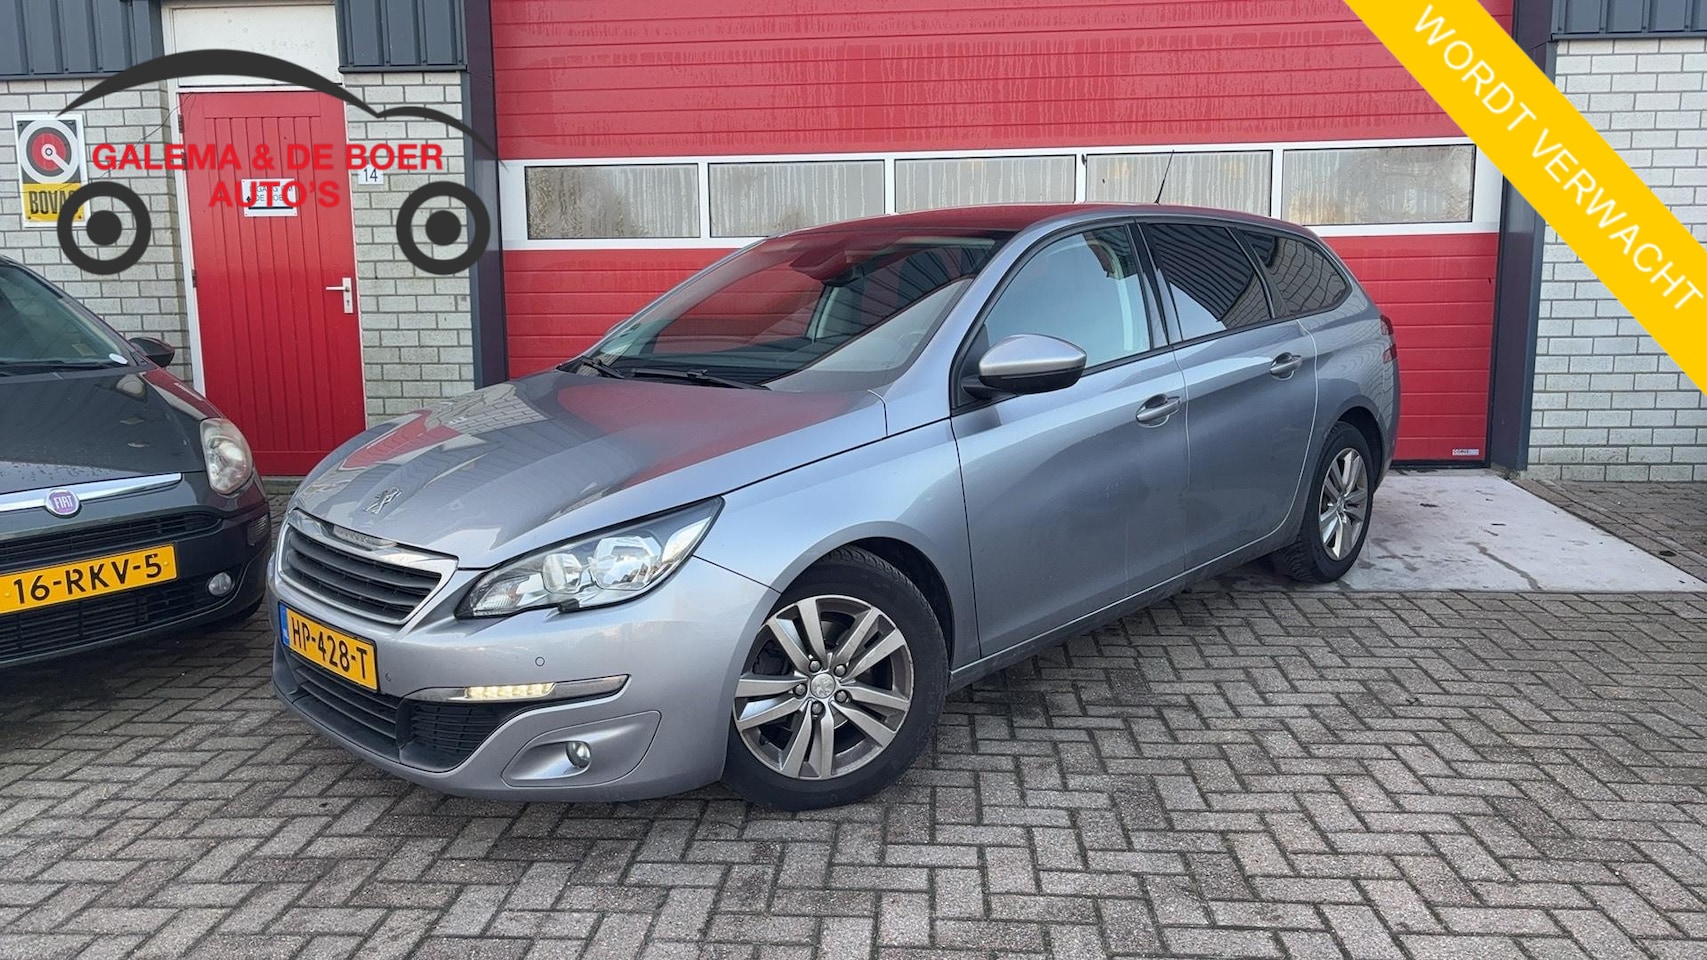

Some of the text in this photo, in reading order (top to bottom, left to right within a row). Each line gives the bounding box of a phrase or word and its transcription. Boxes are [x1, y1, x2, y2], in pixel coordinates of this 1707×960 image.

[363, 168, 378, 182] 14
[53, 495, 74, 509] FIAT
[13, 553, 162, 604] 16-RKV-5
[291, 616, 368, 680] HP-428-T
